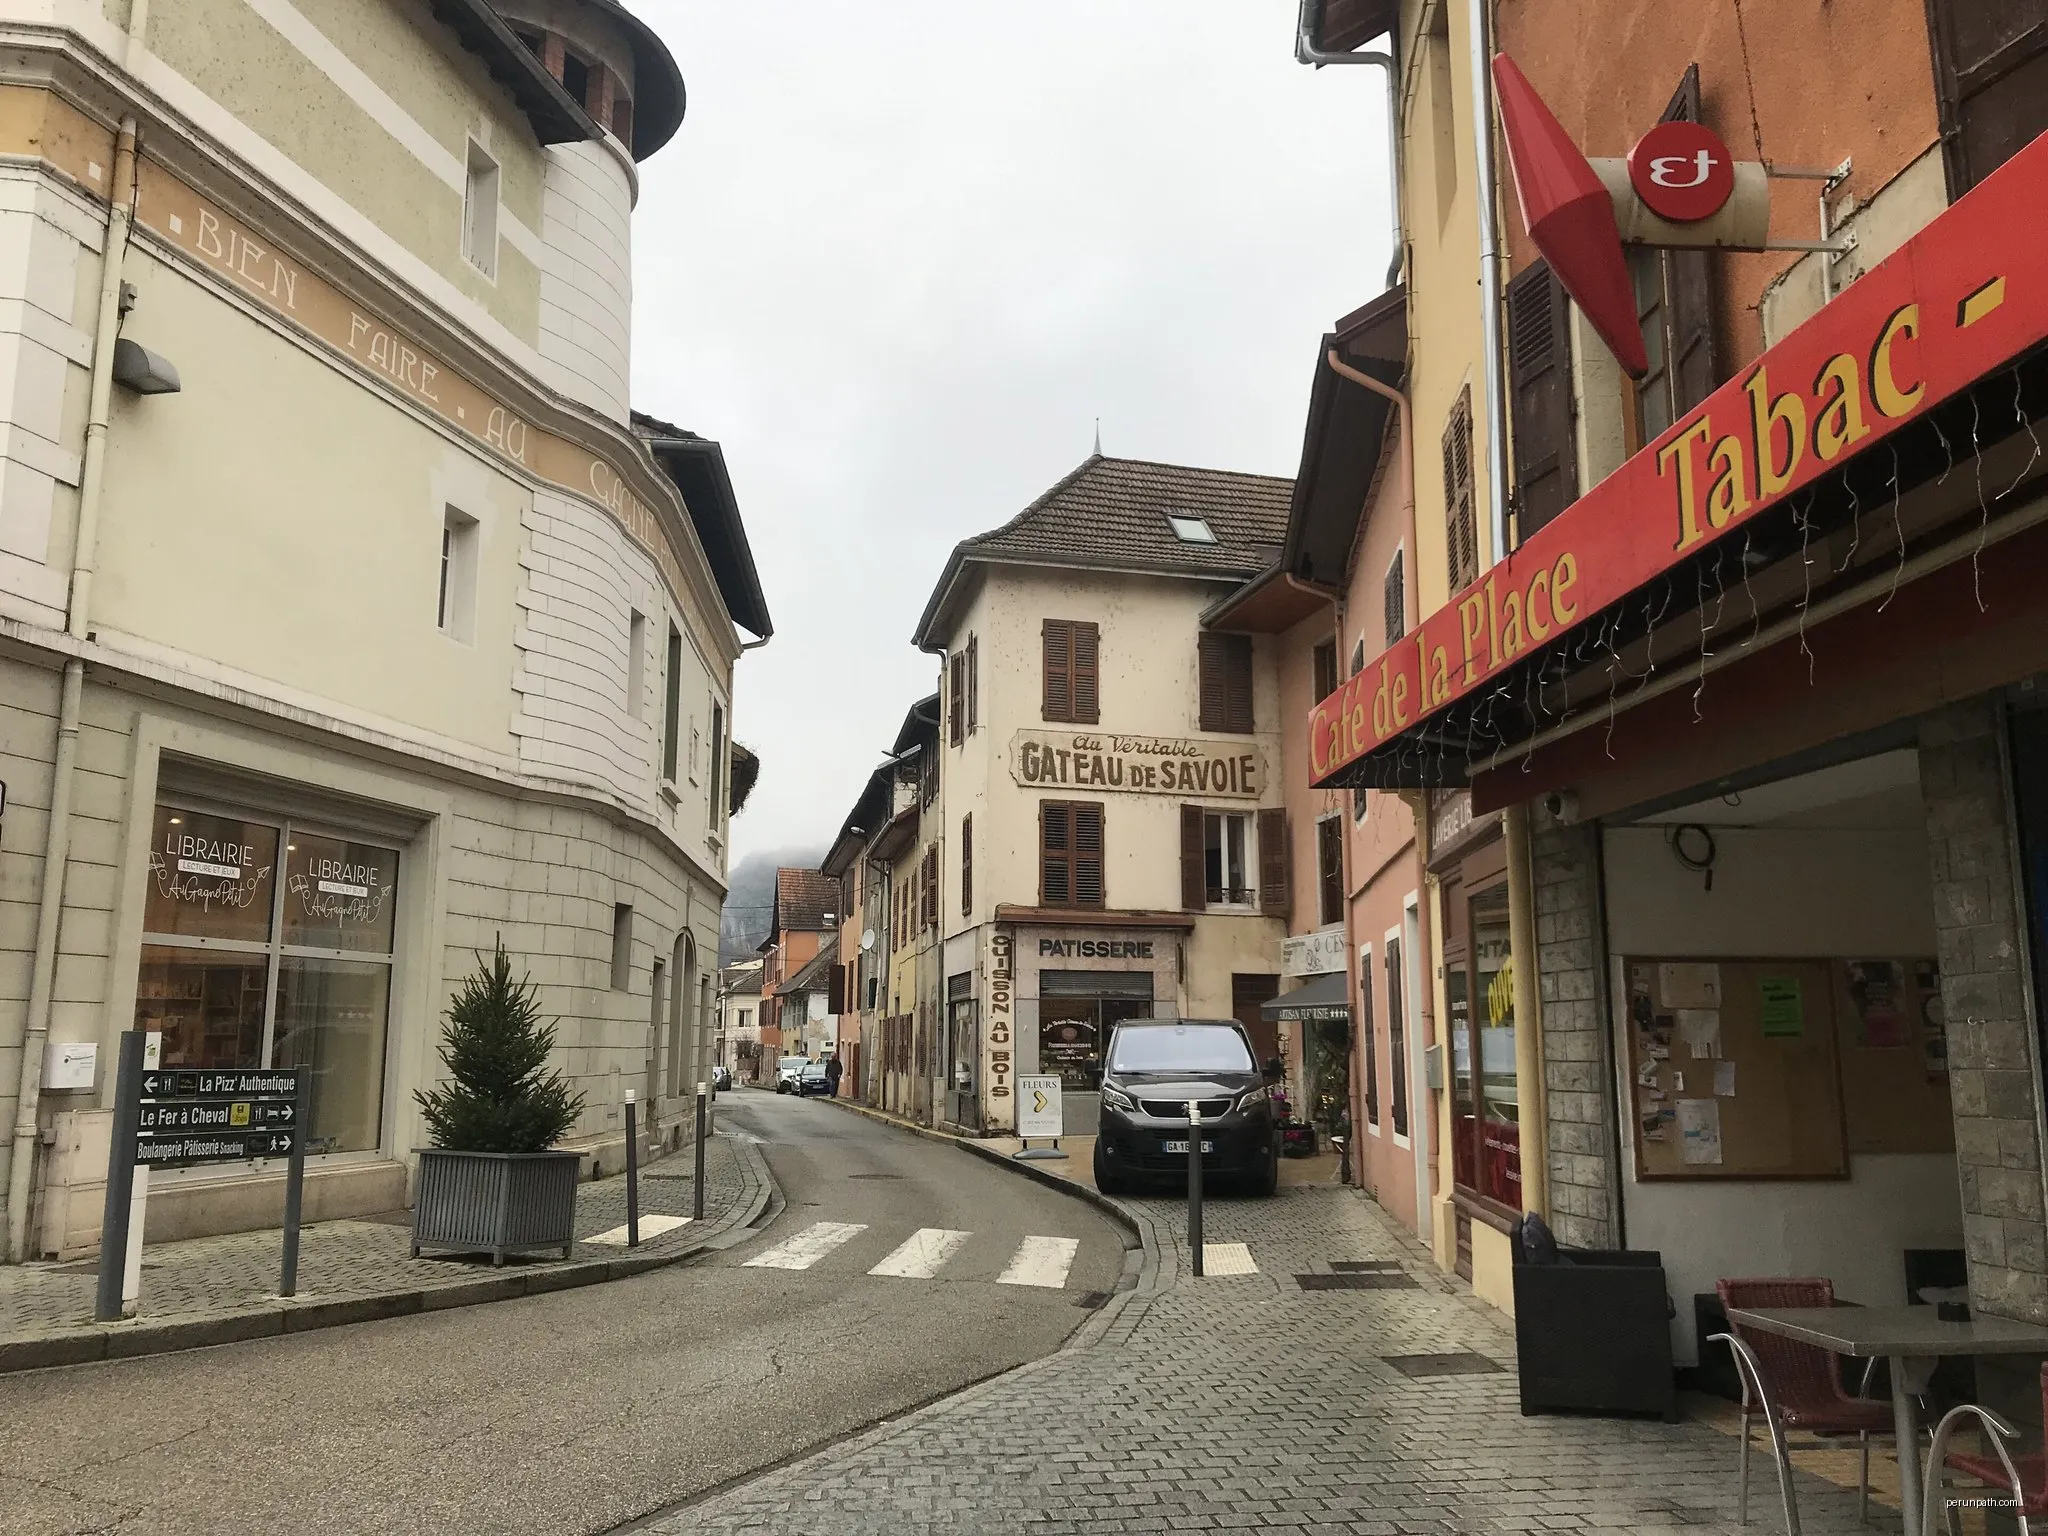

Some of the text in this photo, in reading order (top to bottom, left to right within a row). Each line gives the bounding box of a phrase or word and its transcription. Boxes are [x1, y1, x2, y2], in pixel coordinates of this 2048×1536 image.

[196, 207, 298, 309] BIEN
[347, 311, 440, 404] FAIRE
[482, 406, 527, 464] AU
[589, 460, 655, 549] GAGNE
[1655, 303, 1926, 553] Tabac
[1310, 551, 1579, 778] Café de la Place
[1107, 735, 1205, 757] Véritable
[1021, 741, 1123, 787] GATEAU
[1160, 755, 1256, 794] SAVOIE
[166, 832, 254, 868] LIBRAIRIE
[182, 860, 237, 877] LECTURE ET JEUX
[309, 856, 379, 887] LIBRAIRIE
[1038, 938, 1154, 959] PATISSERIE
[991, 935, 1010, 1098] CUISSON AU BOIS
[1279, 1009, 1300, 1020] ARTISAN
[199, 1075, 212, 1092] La
[215, 1075, 238, 1092] Pizz'
[239, 1075, 295, 1094] Authentique
[1022, 1080, 1058, 1089] FLEURS
[140, 1109, 155, 1127] Le
[158, 1108, 179, 1126] Fer
[180, 1107, 188, 1125] à
[191, 1106, 229, 1125] Cheval
[137, 1138, 244, 1162] Boulangerie Pâtisserie Snacking
